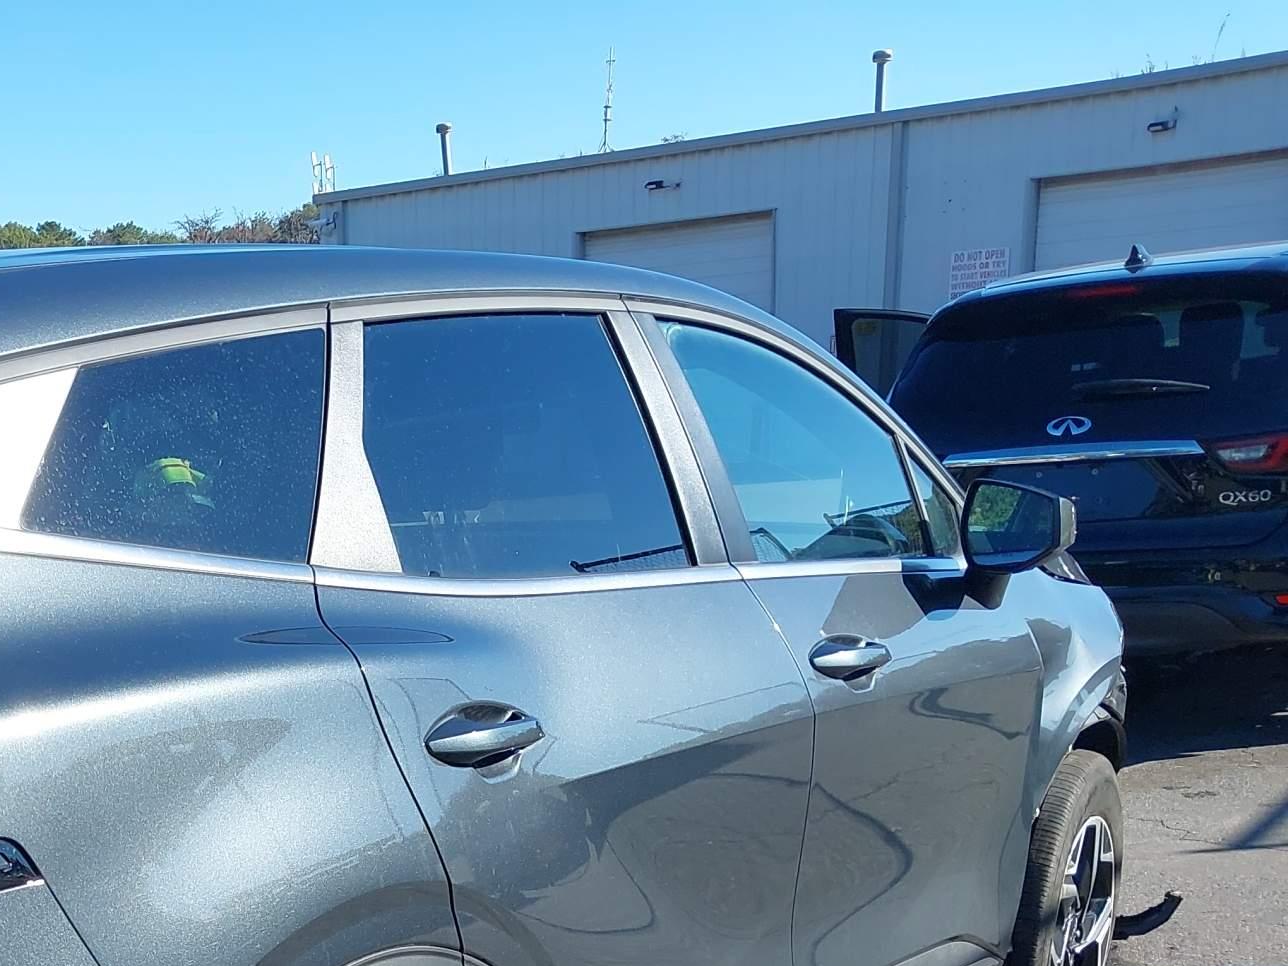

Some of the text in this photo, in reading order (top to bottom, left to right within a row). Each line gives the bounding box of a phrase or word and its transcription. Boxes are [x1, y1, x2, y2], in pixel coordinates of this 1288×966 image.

[954, 249, 1005, 263] DO NOT OPEN
[1218, 489, 1272, 506] QX60
